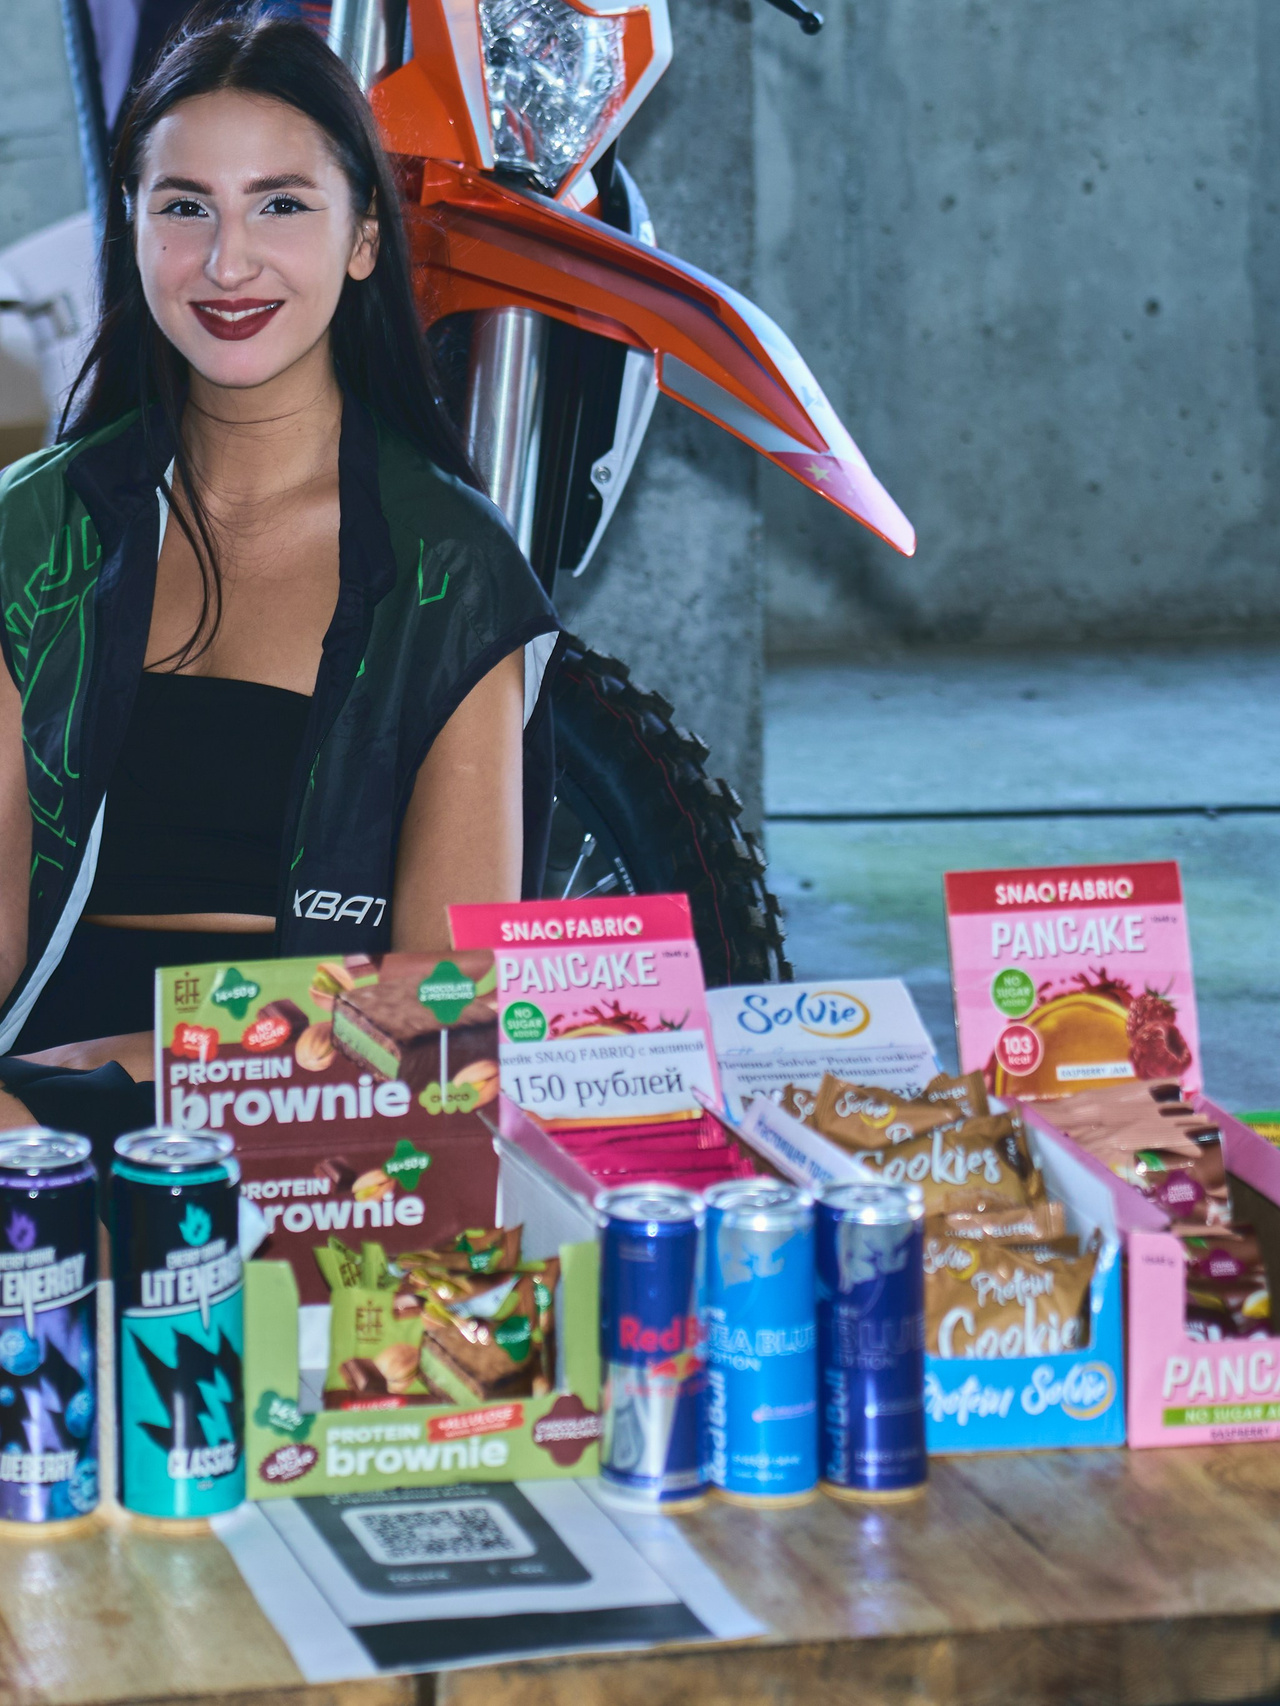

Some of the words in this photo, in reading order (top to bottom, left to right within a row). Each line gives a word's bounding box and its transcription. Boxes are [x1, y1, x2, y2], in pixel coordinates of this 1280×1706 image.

[995, 883, 1055, 905] SNAQ
[1058, 878, 1133, 902] FABRIQ
[501, 920, 564, 942] SNAQ
[566, 915, 644, 939] FABRIQ
[992, 914, 1145, 959] PANCAKE
[500, 951, 659, 994] PANCAKE
[1004, 975, 1021, 988] NO
[996, 986, 1031, 998] SUGAR
[513, 1007, 534, 1019] NO
[738, 990, 857, 1035] Solvie
[247, 1025, 286, 1046] SUGAR
[256, 1020, 275, 1033] NO
[506, 1019, 543, 1031] SUGAR
[535, 1049, 577, 1065] SNAQ
[580, 1045, 636, 1062] FABRIQ
[1003, 1036, 1032, 1055] 103
[1008, 1053, 1031, 1065] kcal
[170, 1056, 294, 1087] PROTEIN
[512, 1073, 566, 1105] 150
[575, 1066, 686, 1107] рублей
[170, 1074, 412, 1131] brownie
[620, 1315, 682, 1352] Red
[1185, 1411, 1211, 1424] NO
[1213, 1407, 1263, 1422] SUGAR
[325, 1423, 421, 1445] PROTEIN
[265, 1451, 315, 1479] SUGAR
[275, 1446, 298, 1463] NO
[325, 1437, 510, 1478] brownie
